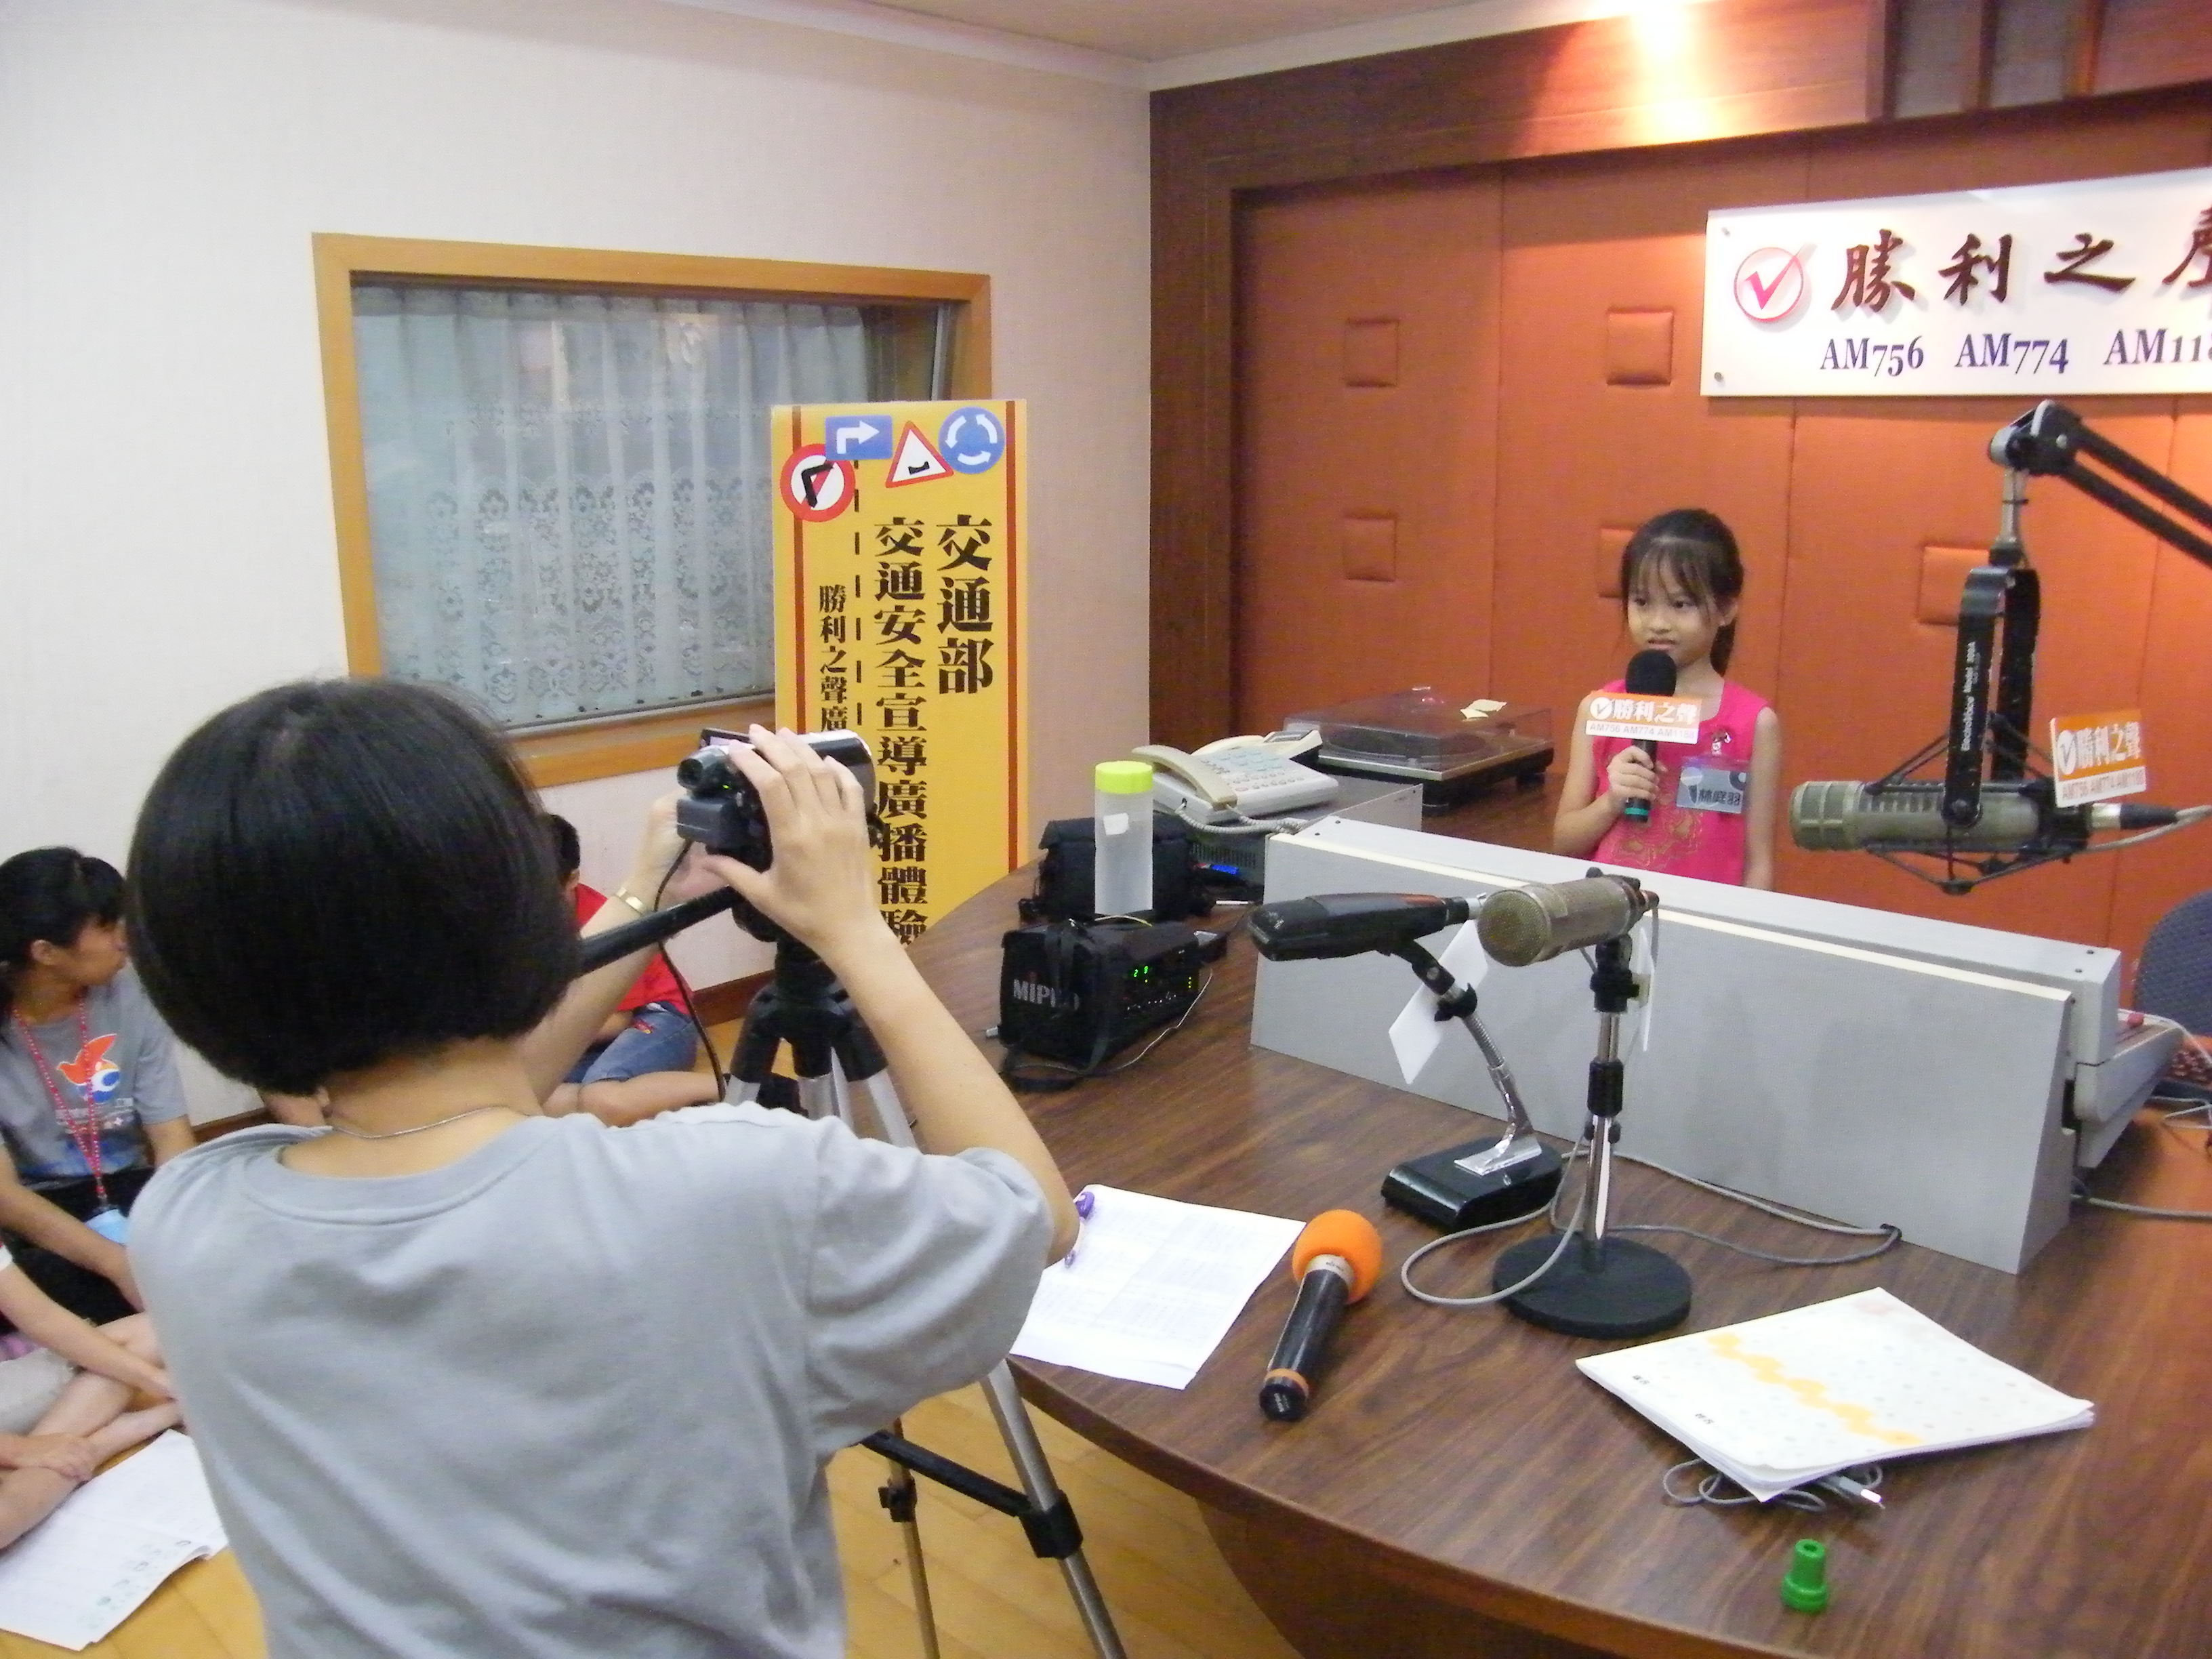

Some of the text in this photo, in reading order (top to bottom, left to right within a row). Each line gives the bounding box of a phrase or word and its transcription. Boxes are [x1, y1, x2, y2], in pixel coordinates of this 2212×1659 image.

[1820, 328, 2212, 377] AM756 AM774 AM11
[936, 514, 995, 695] 交通部
[874, 516, 928, 945] 交通安全宣導廣播體驗
[1589, 723, 1620, 733] AM756
[1623, 725, 1655, 736] AM774
